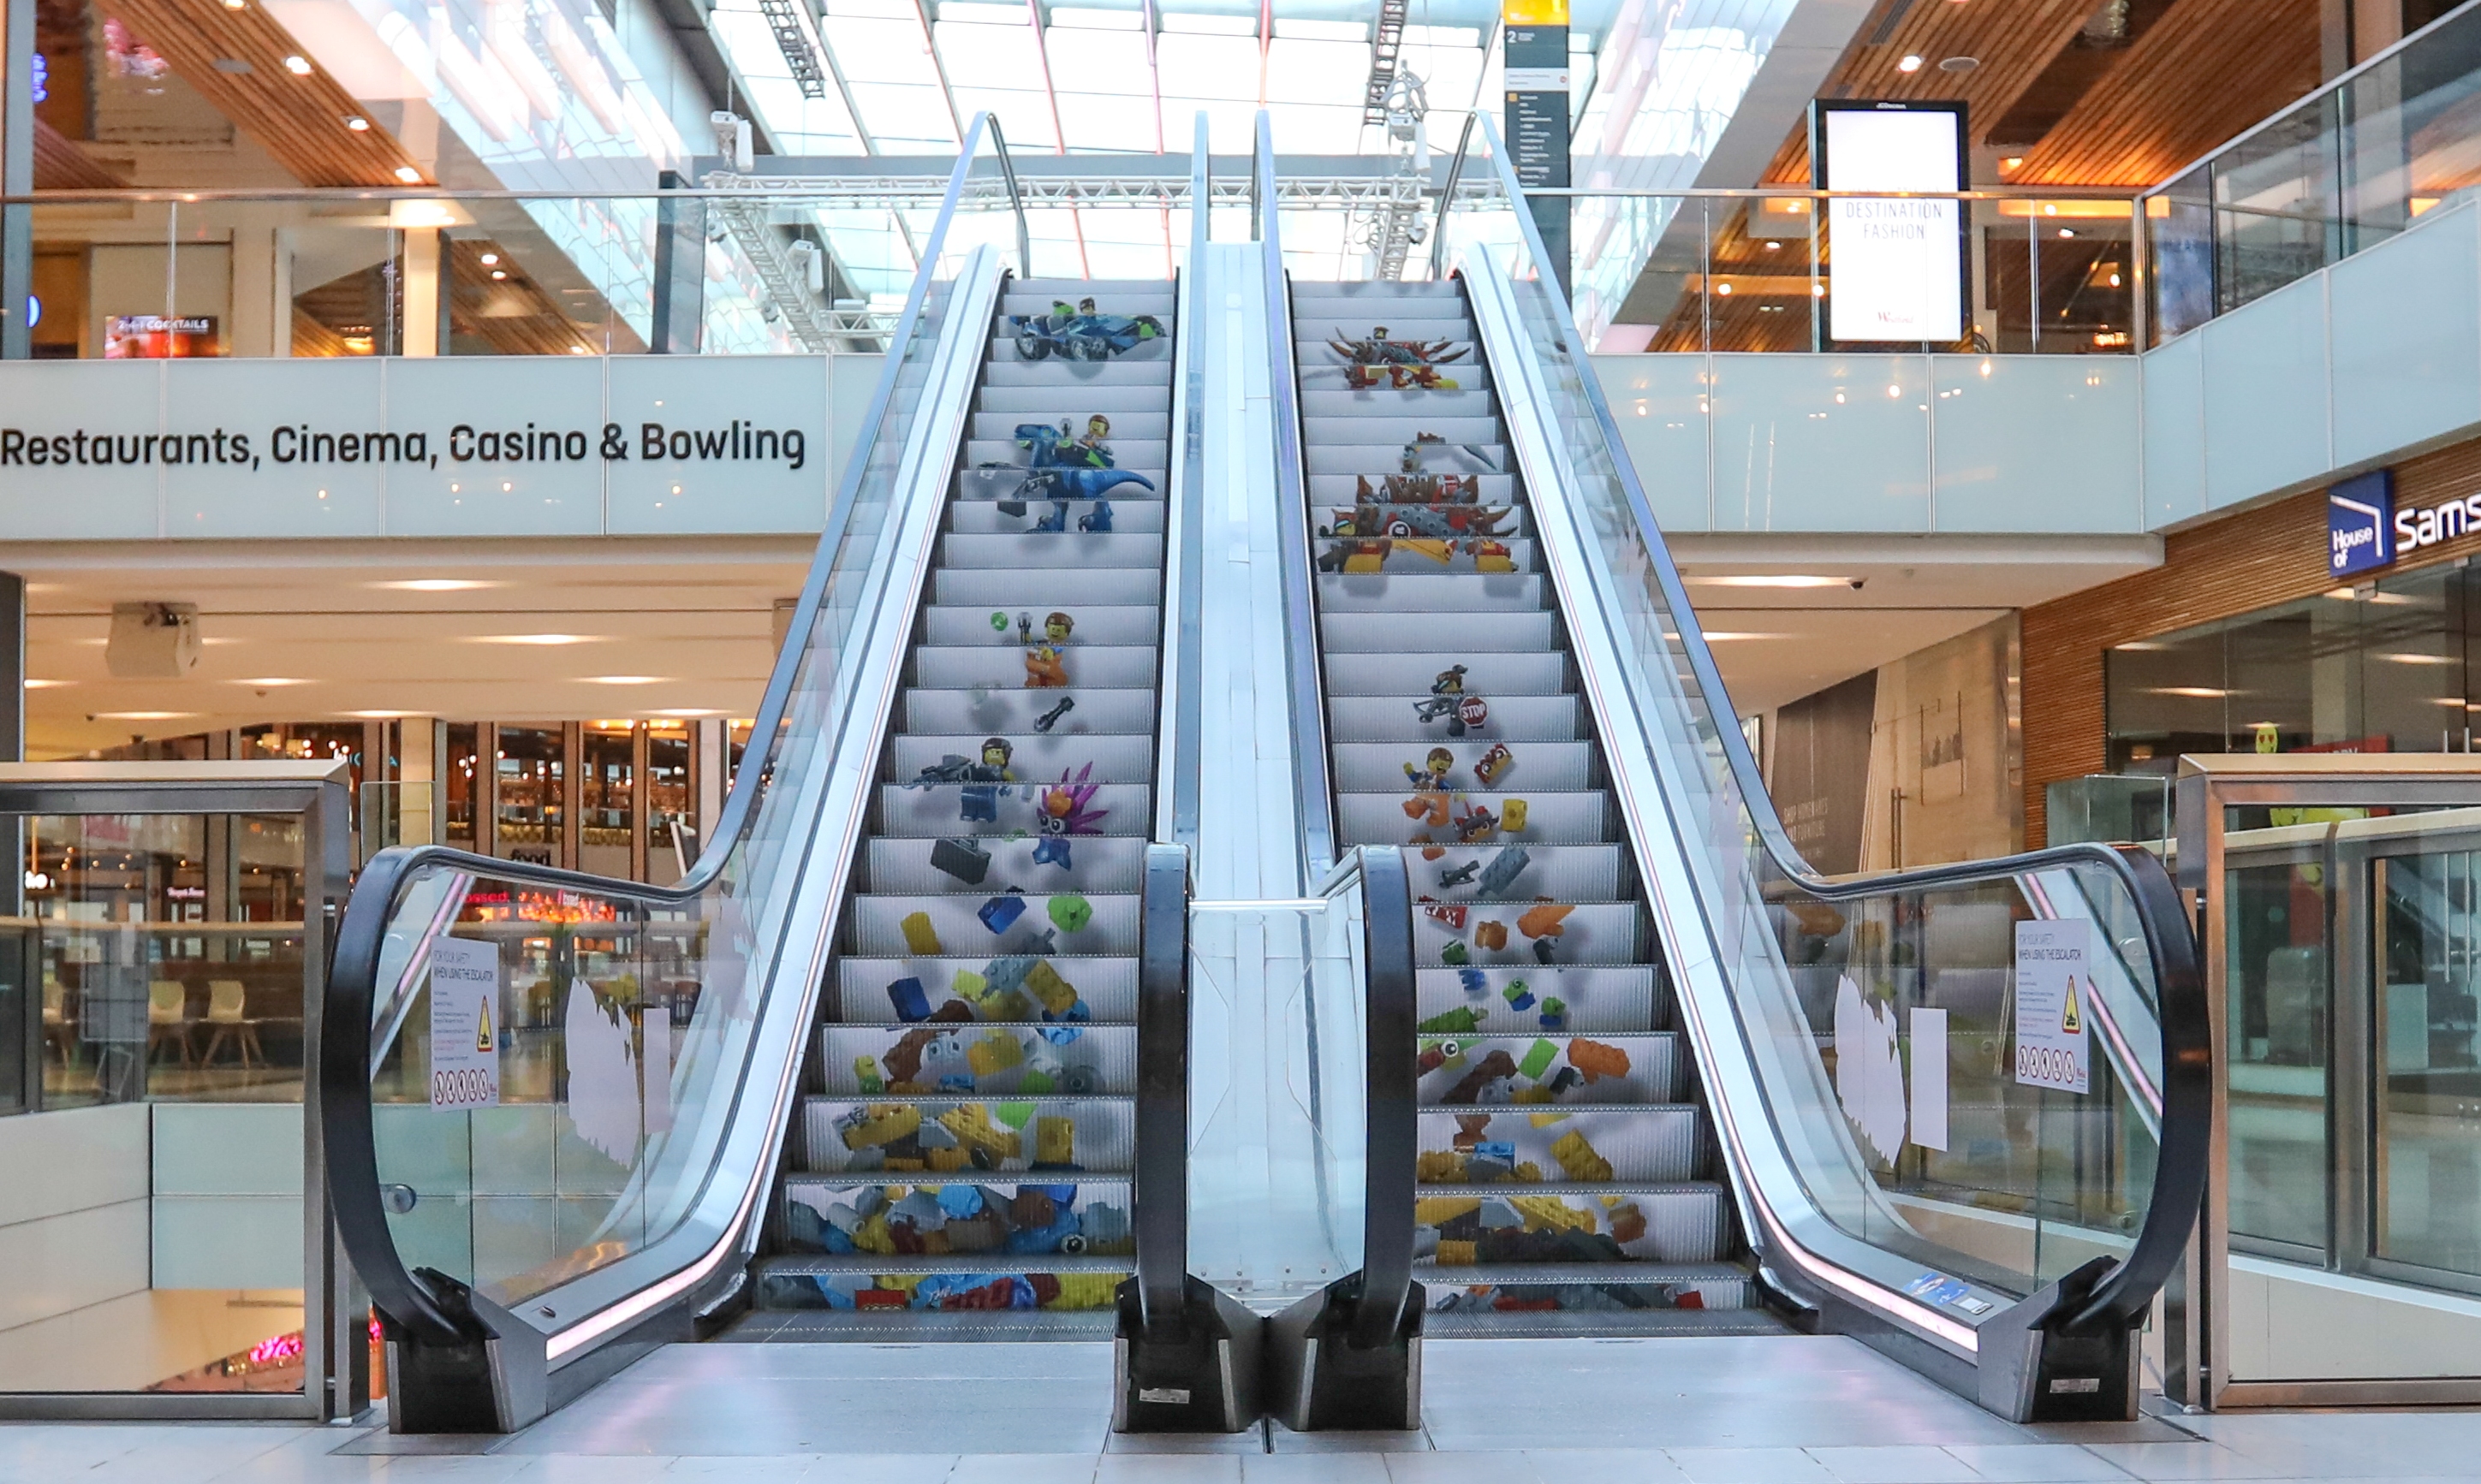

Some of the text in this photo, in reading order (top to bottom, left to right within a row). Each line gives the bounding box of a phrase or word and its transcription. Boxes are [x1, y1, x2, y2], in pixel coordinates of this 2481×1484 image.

[1507, 30, 1517, 44] 2
[1846, 201, 1943, 219] DESTINATION
[1864, 223, 1925, 240] FASHION
[0, 418, 806, 472] Restaurants, Cinema, Casino & Bowling
[2332, 526, 2374, 551] House
[2333, 549, 2348, 568] of
[1461, 703, 1486, 719] STOP
